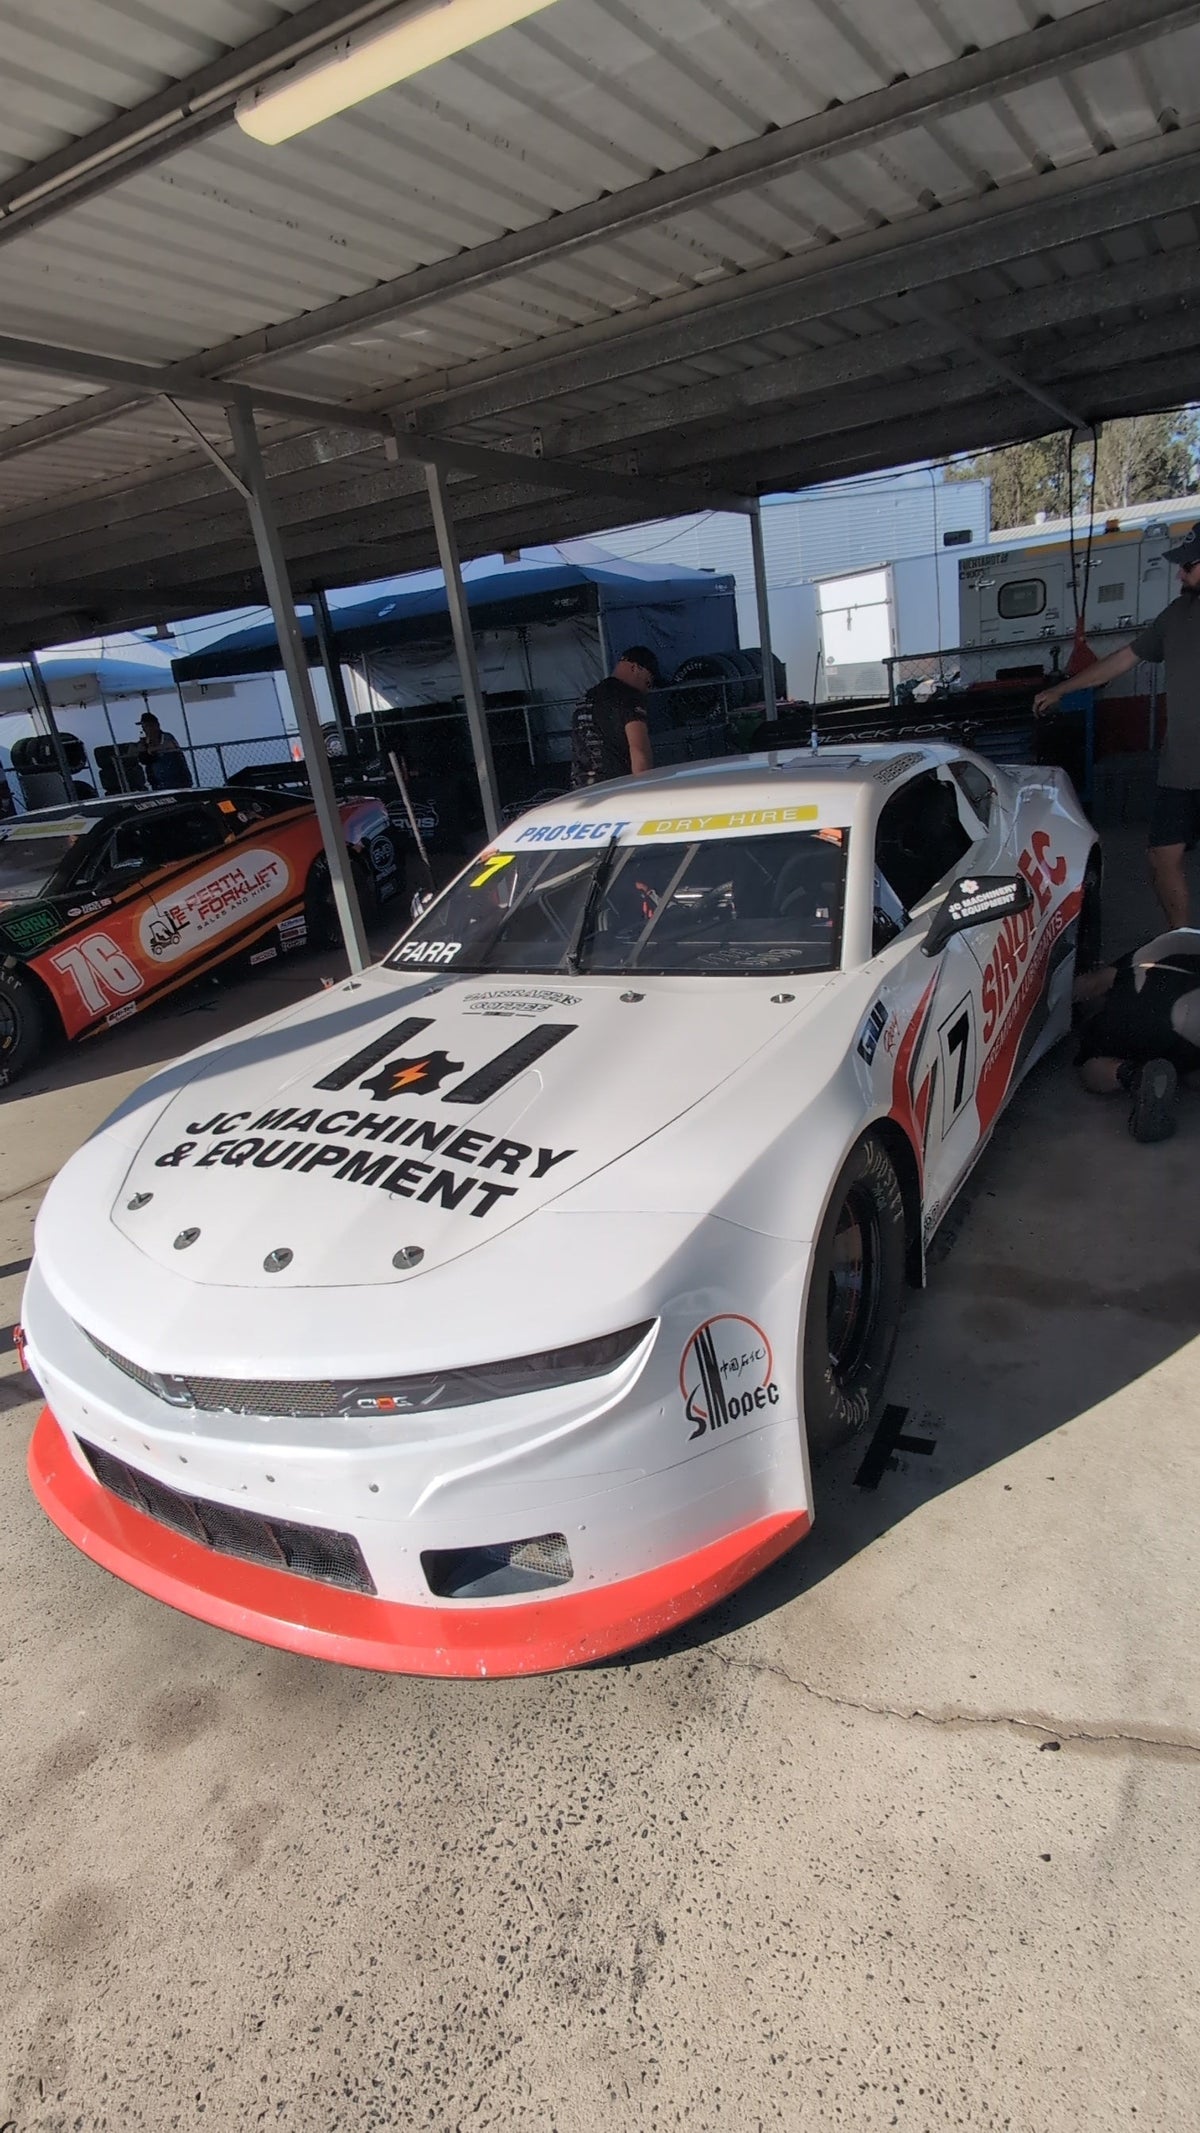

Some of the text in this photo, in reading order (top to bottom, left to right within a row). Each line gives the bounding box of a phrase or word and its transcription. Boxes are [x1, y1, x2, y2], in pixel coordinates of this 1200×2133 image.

[895, 721, 955, 735] FOX
[655, 809, 800, 833] DRY HIRE
[470, 855, 516, 888] 7
[185, 868, 245, 911] PERTH
[197, 862, 279, 921] FORKLIFT
[948, 883, 1017, 913] JC MACHINERY
[960, 893, 1015, 917] EQUIPMENT
[197, 884, 271, 930] SALES AND HIRE
[8, 912, 54, 938] CLARK
[394, 942, 463, 964] FARR
[49, 932, 144, 1016] 76
[470, 1002, 553, 1012] COFFEE
[947, 1009, 970, 1114] 7
[186, 1108, 578, 1179] JC MACHINERY
[154, 1137, 519, 1218] & EQUIPMENT
